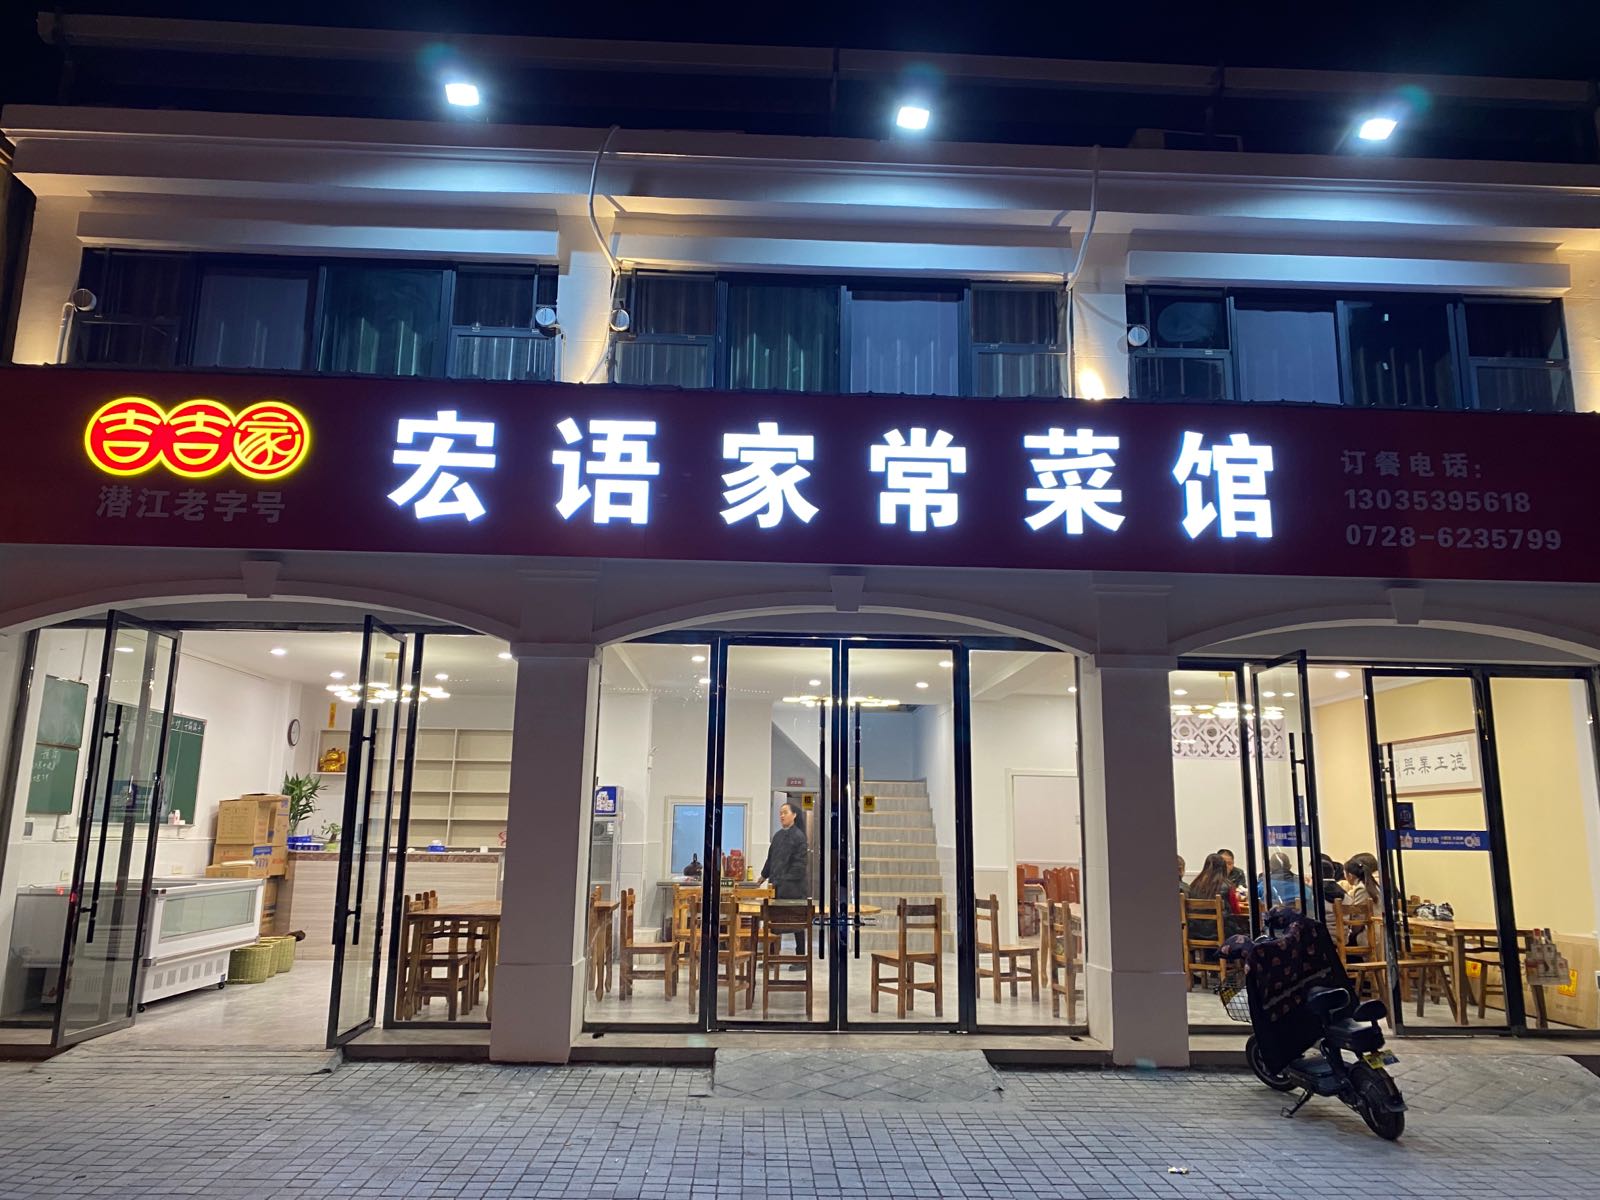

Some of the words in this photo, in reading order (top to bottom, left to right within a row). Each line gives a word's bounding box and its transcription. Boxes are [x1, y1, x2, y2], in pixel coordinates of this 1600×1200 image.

[98, 407, 304, 470] 吉吉家
[387, 409, 1274, 539] 宏语家常菜馆
[97, 486, 286, 523] 潜江老字号
[1344, 488, 1532, 514] 13035395618
[1345, 523, 1563, 551] 0728-6235799
